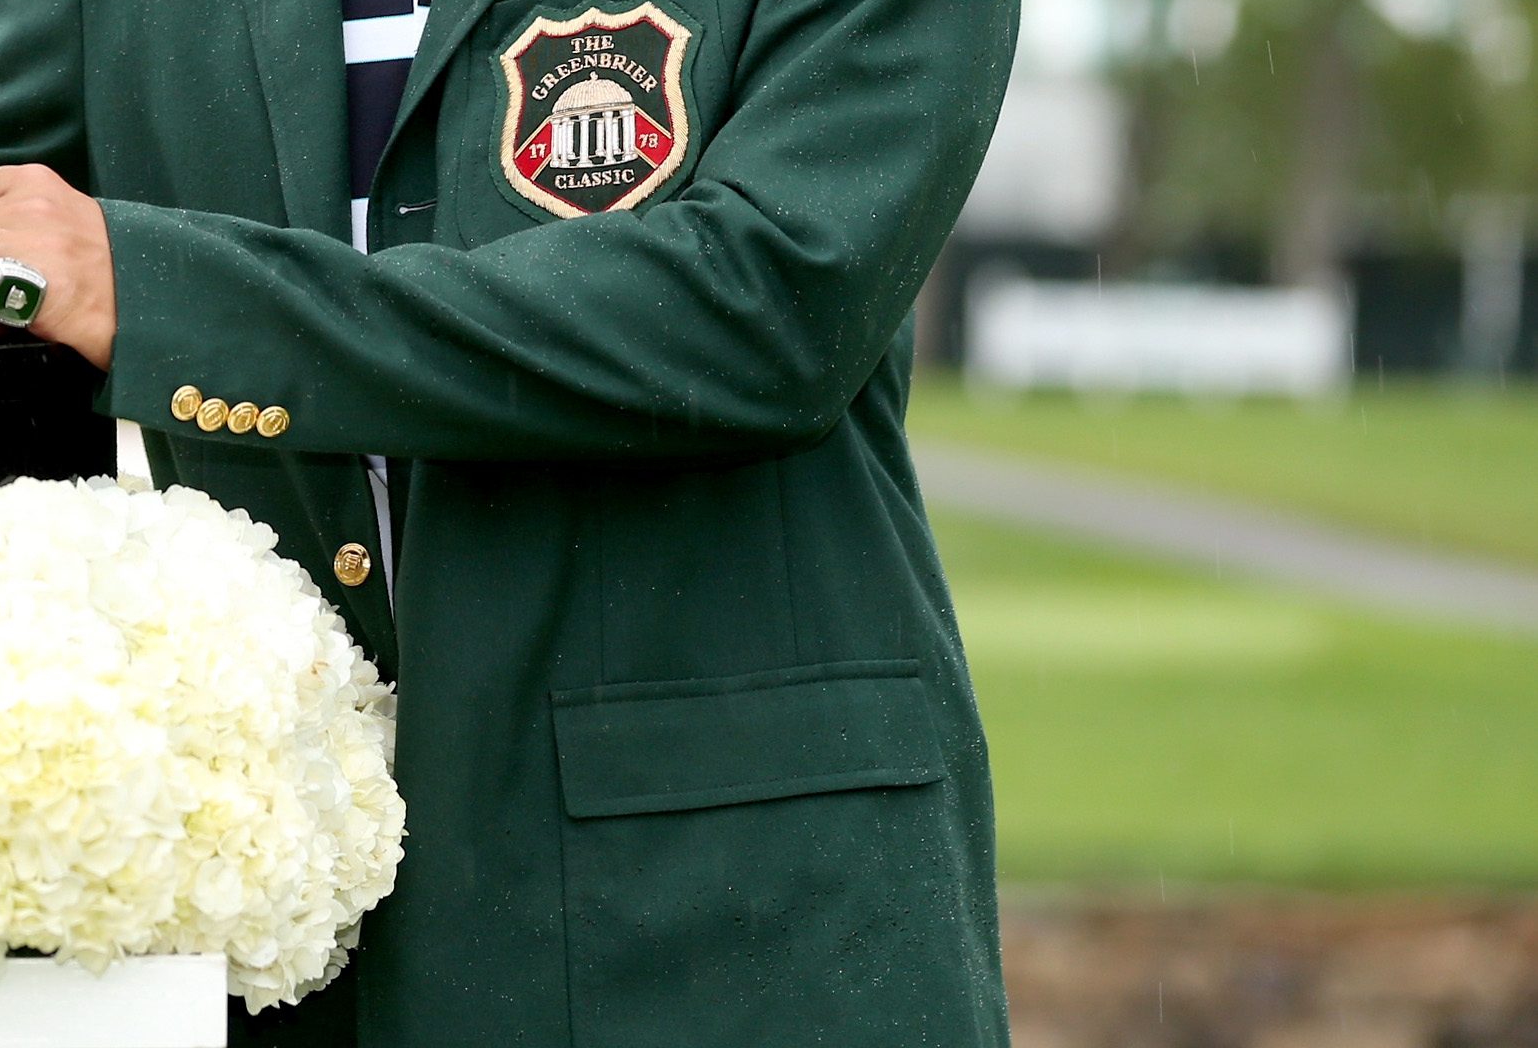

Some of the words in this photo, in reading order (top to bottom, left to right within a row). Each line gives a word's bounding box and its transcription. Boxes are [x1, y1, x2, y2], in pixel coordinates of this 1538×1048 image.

[570, 35, 614, 54] THE
[531, 52, 658, 101] GREENBRIER
[528, 143, 548, 160] 17
[638, 133, 659, 149] 78
[554, 168, 635, 190] CLASSIC
